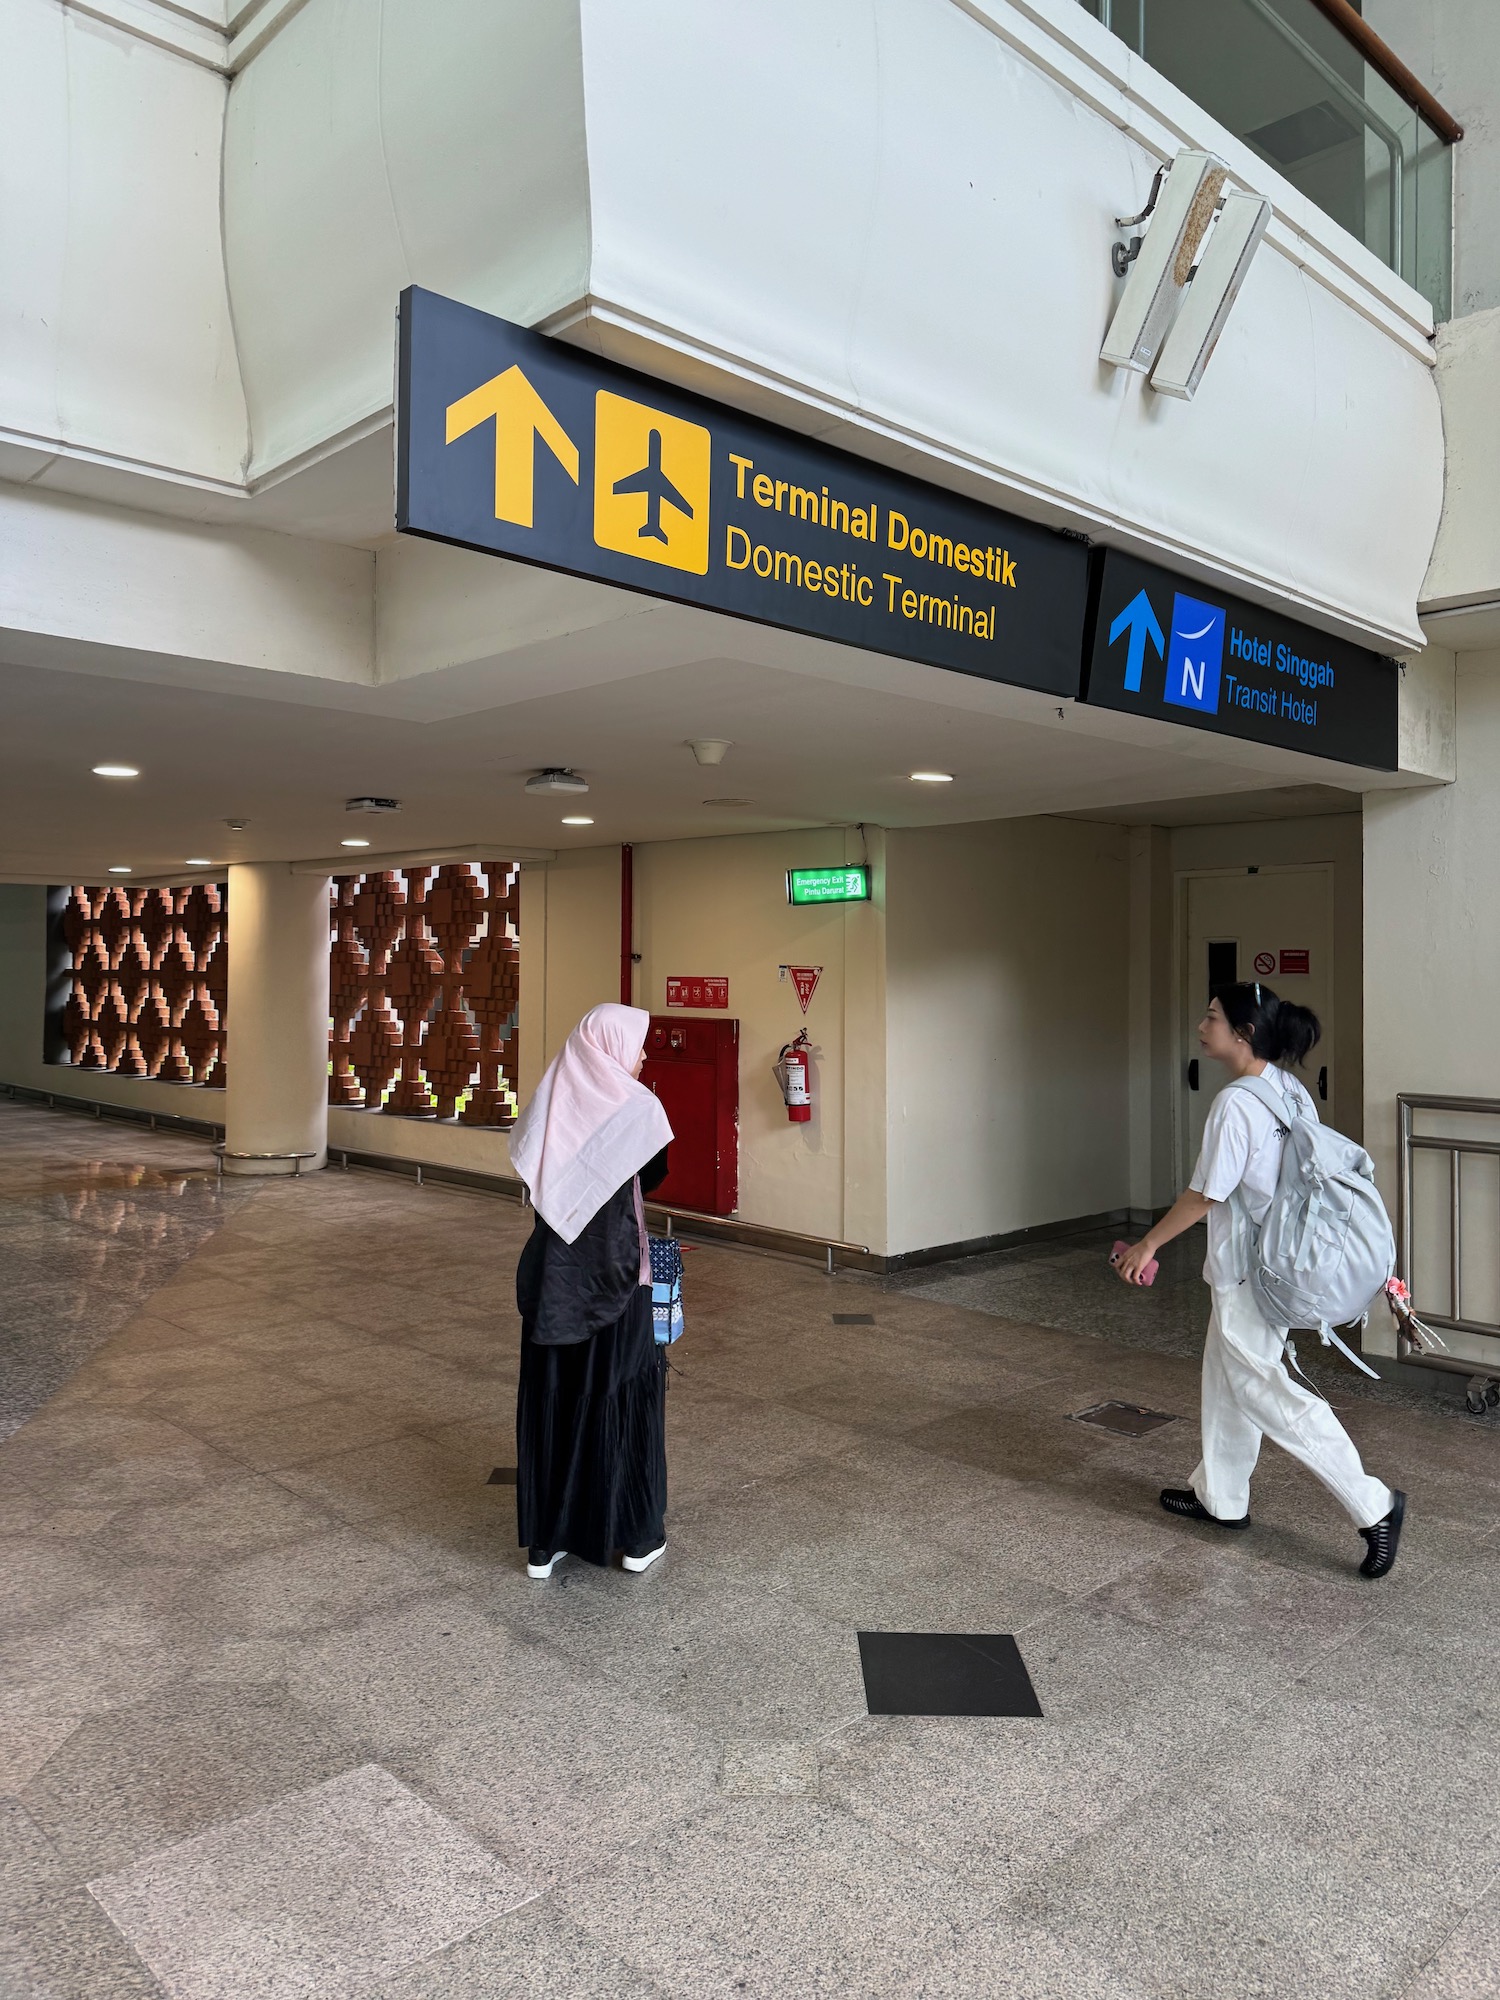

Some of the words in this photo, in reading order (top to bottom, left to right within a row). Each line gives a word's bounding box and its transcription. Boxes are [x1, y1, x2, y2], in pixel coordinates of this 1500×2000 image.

[729, 454, 877, 543] Terminal
[887, 510, 1017, 588] Domestik
[725, 525, 874, 606] Domestic
[882, 573, 996, 641] Terminal
[1181, 656, 1206, 700] N
[1230, 627, 1272, 667] Hotel
[1275, 643, 1335, 689] Singgah
[1225, 674, 1277, 716] Transit
[1280, 690, 1318, 726] Hotel
[796, 877, 831, 886] Emergency
[832, 876, 844, 884] Exit
[804, 888, 821, 896] Pintu
[822, 887, 845, 895] Darurat
